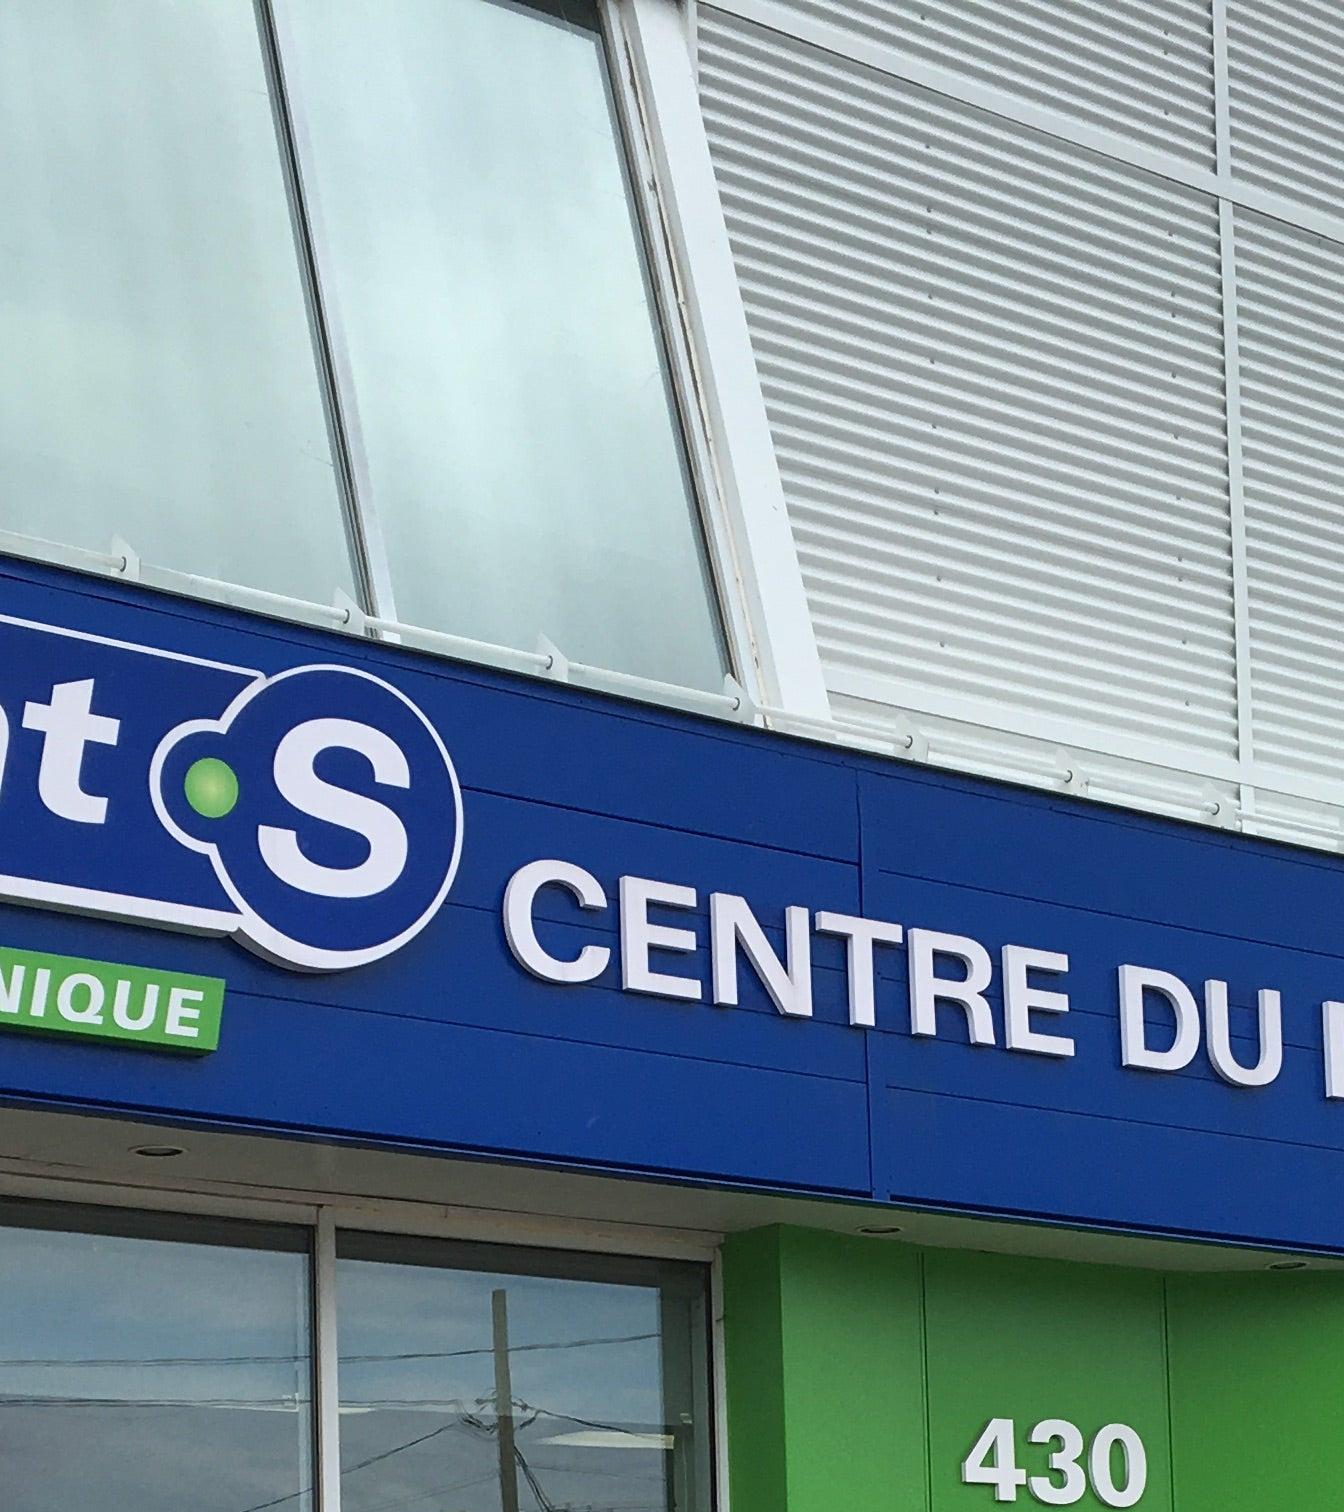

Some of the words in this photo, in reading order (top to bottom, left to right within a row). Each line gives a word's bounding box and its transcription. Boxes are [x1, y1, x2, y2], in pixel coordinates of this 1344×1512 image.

[502, 859, 1075, 1056] CENTRE
[1118, 964, 1281, 1087] DU
[961, 1418, 1147, 1508] 430
